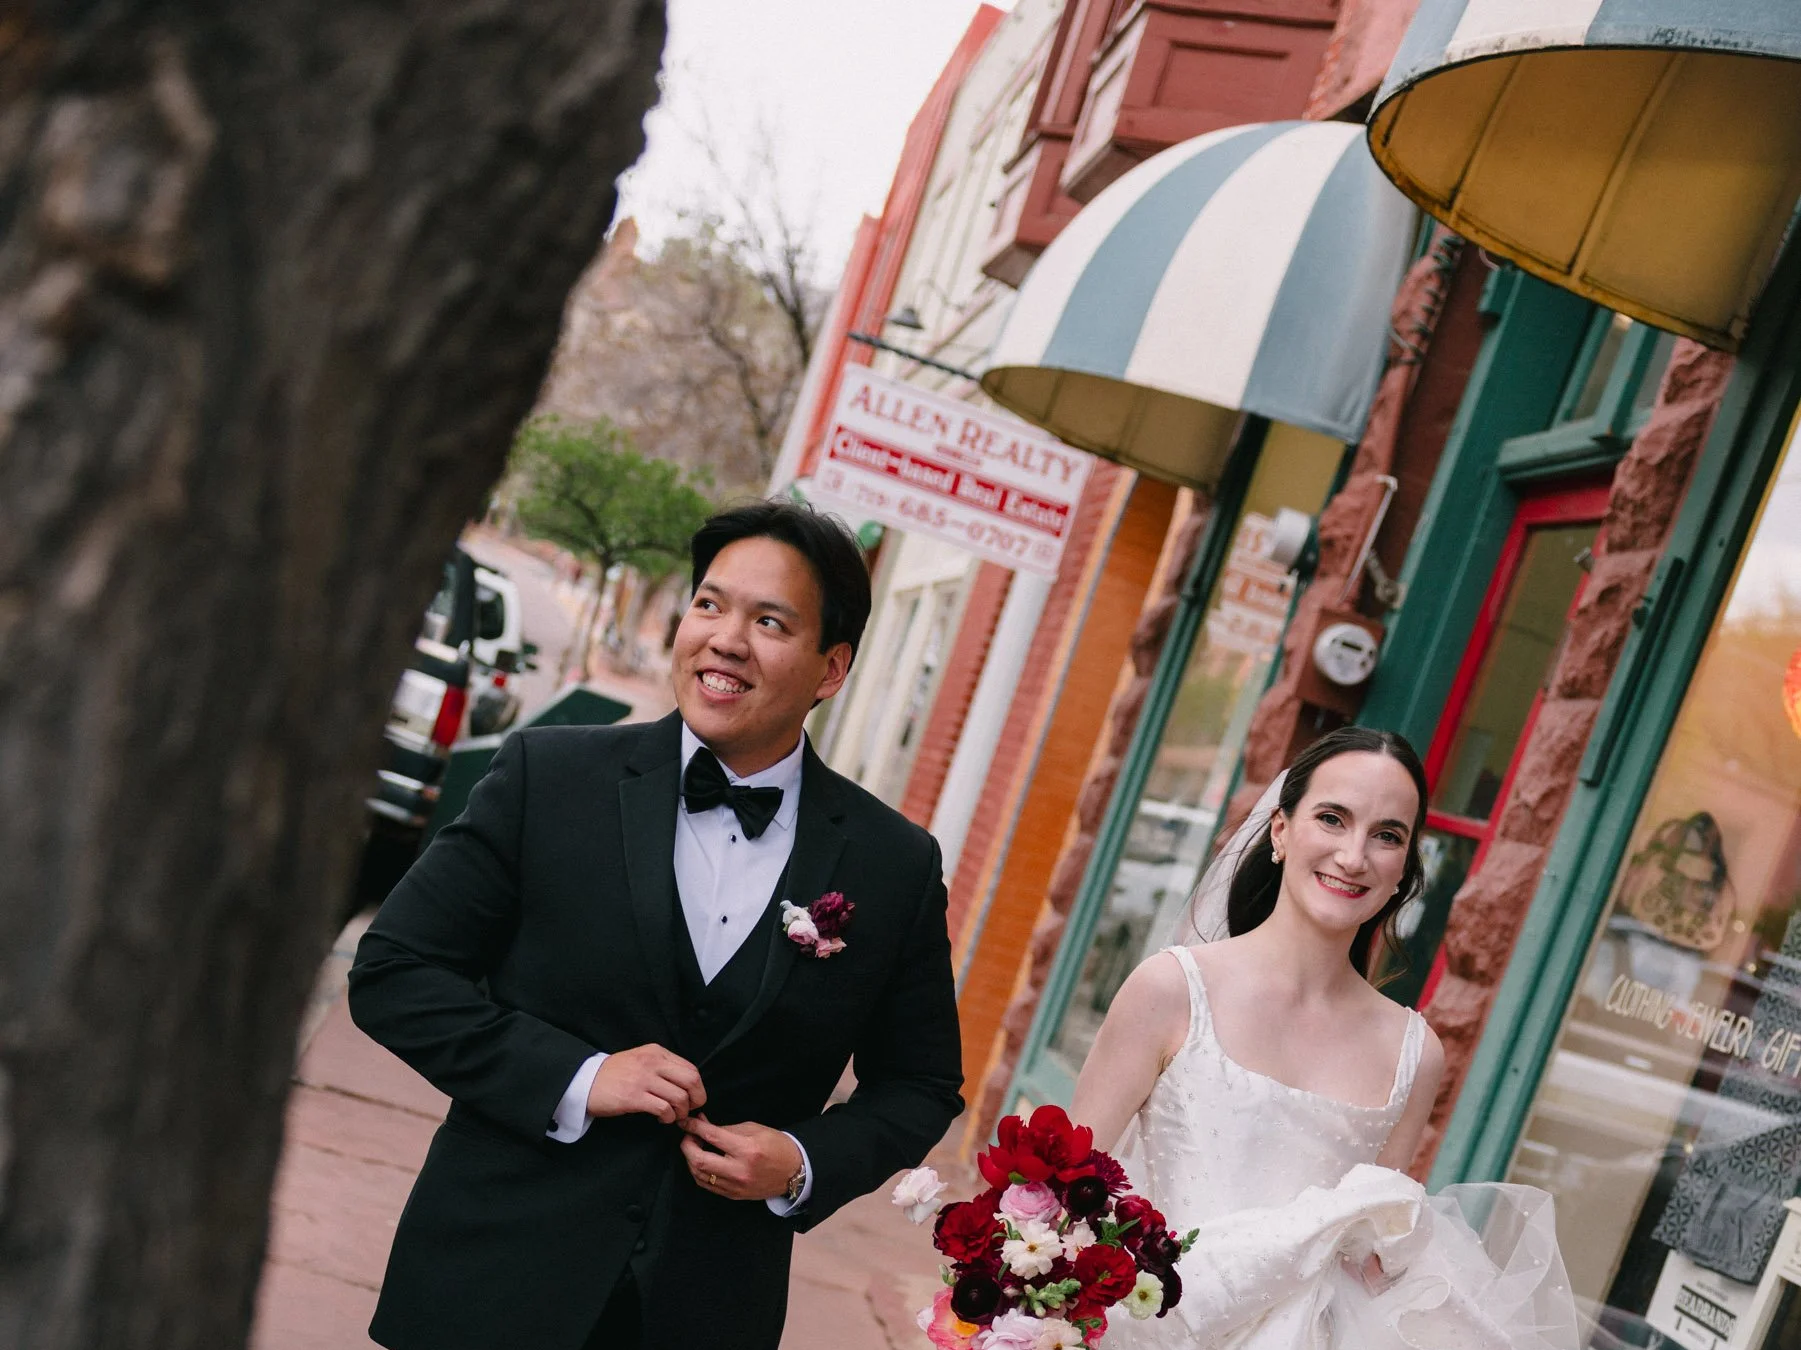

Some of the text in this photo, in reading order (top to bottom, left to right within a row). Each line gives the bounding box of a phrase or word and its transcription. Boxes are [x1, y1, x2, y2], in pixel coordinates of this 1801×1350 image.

[848, 383, 951, 435] ALLEN
[959, 417, 1081, 484] REALTY
[1605, 973, 1678, 1030] CLOTHING
[1674, 1001, 1763, 1059] JEWELRY
